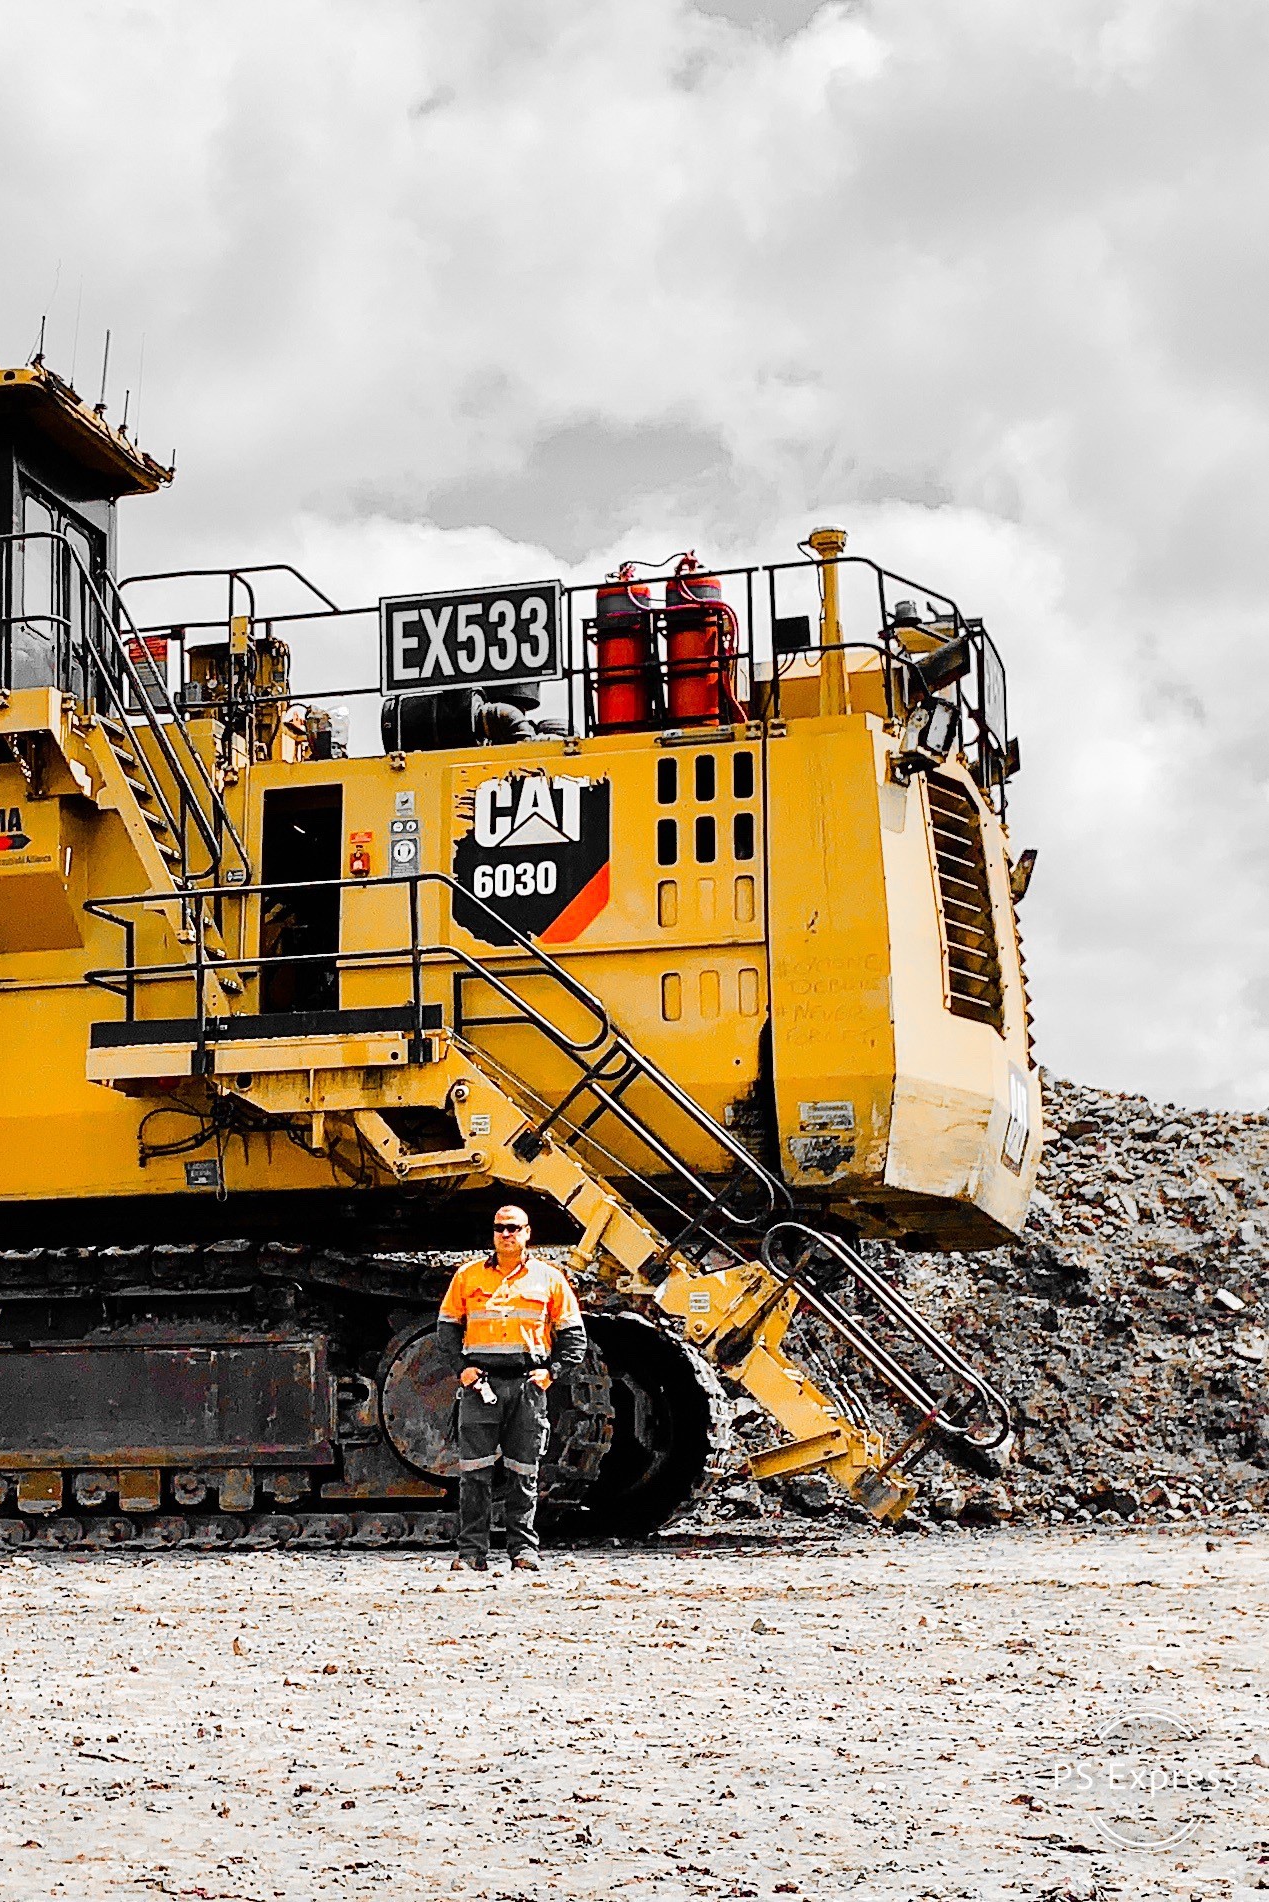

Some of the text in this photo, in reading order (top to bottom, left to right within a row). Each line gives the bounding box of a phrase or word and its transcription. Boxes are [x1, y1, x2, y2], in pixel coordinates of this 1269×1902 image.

[392, 596, 550, 681] EX533
[474, 774, 591, 848] CAT
[473, 860, 558, 899] 6030
